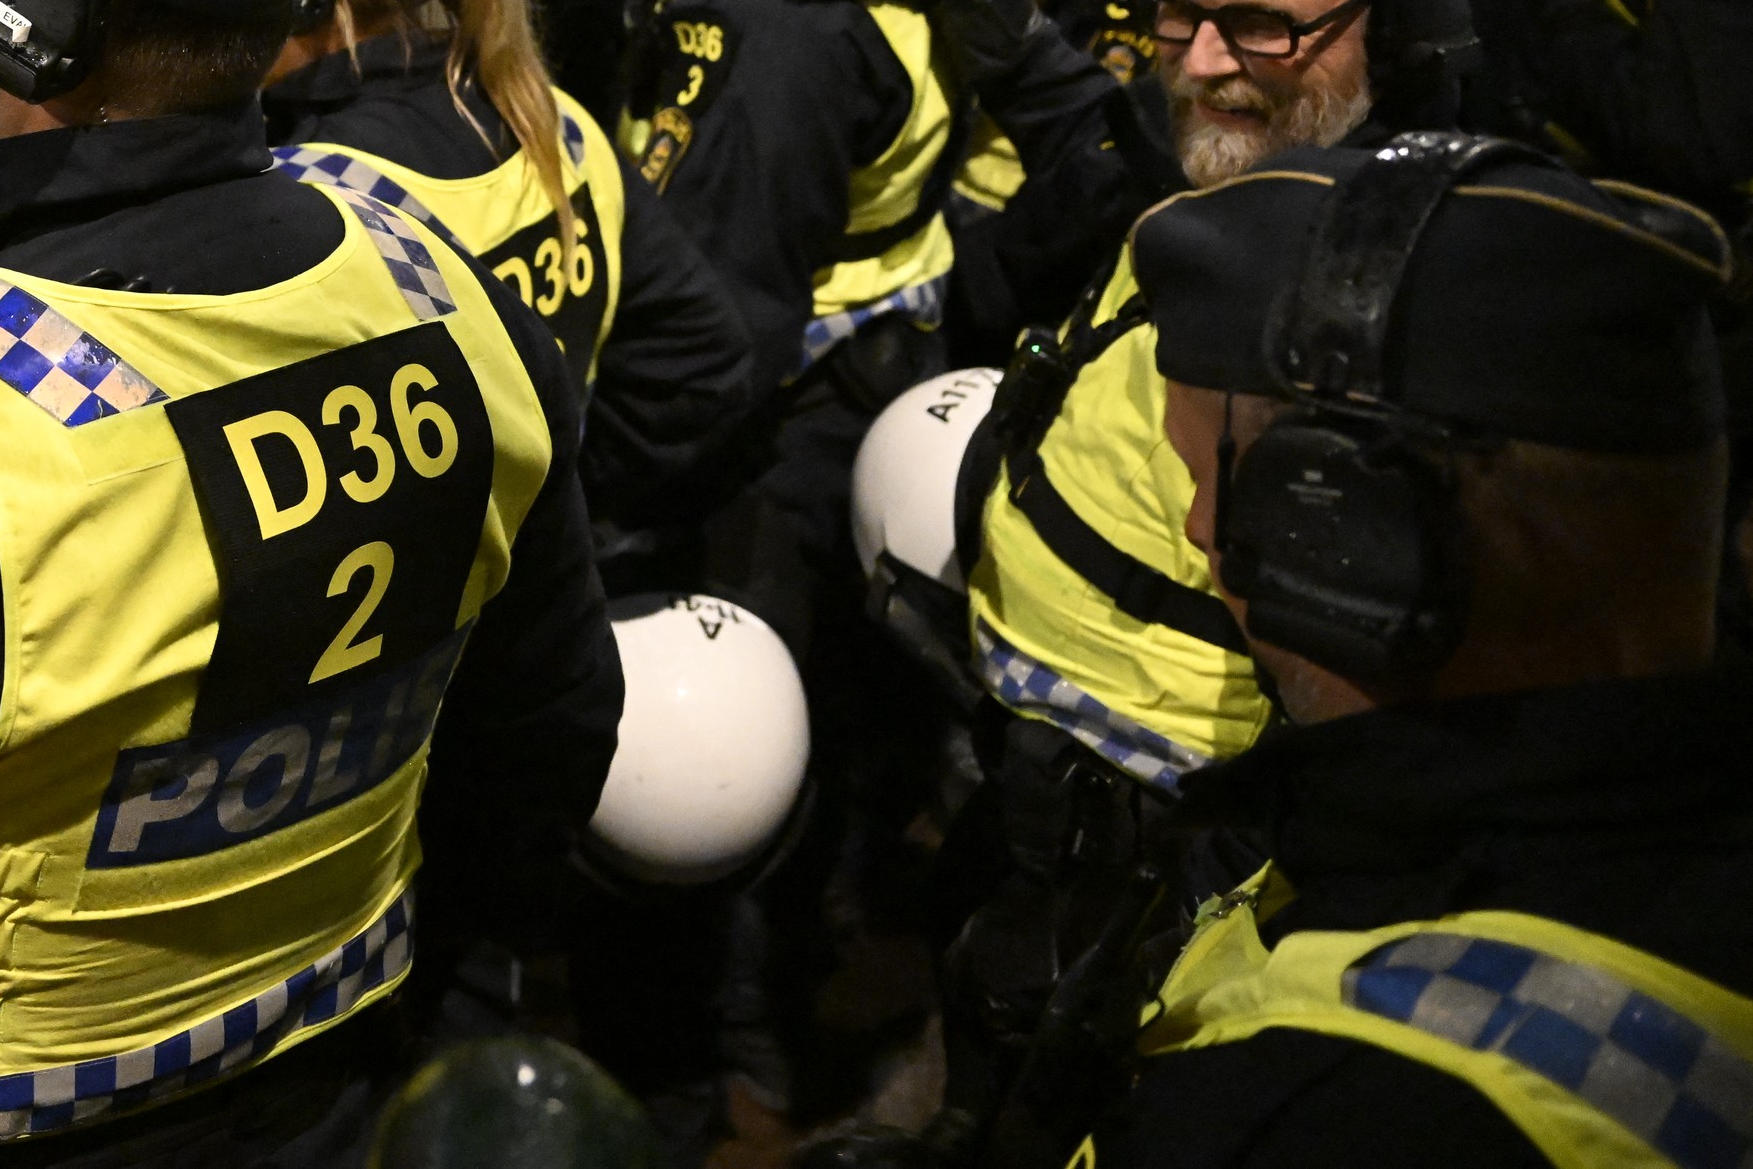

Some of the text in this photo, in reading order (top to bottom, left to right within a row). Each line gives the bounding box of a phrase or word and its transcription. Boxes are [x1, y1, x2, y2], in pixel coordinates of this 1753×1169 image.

[672, 21, 723, 62] D36
[222, 363, 458, 540] D36
[308, 541, 394, 684] 2
